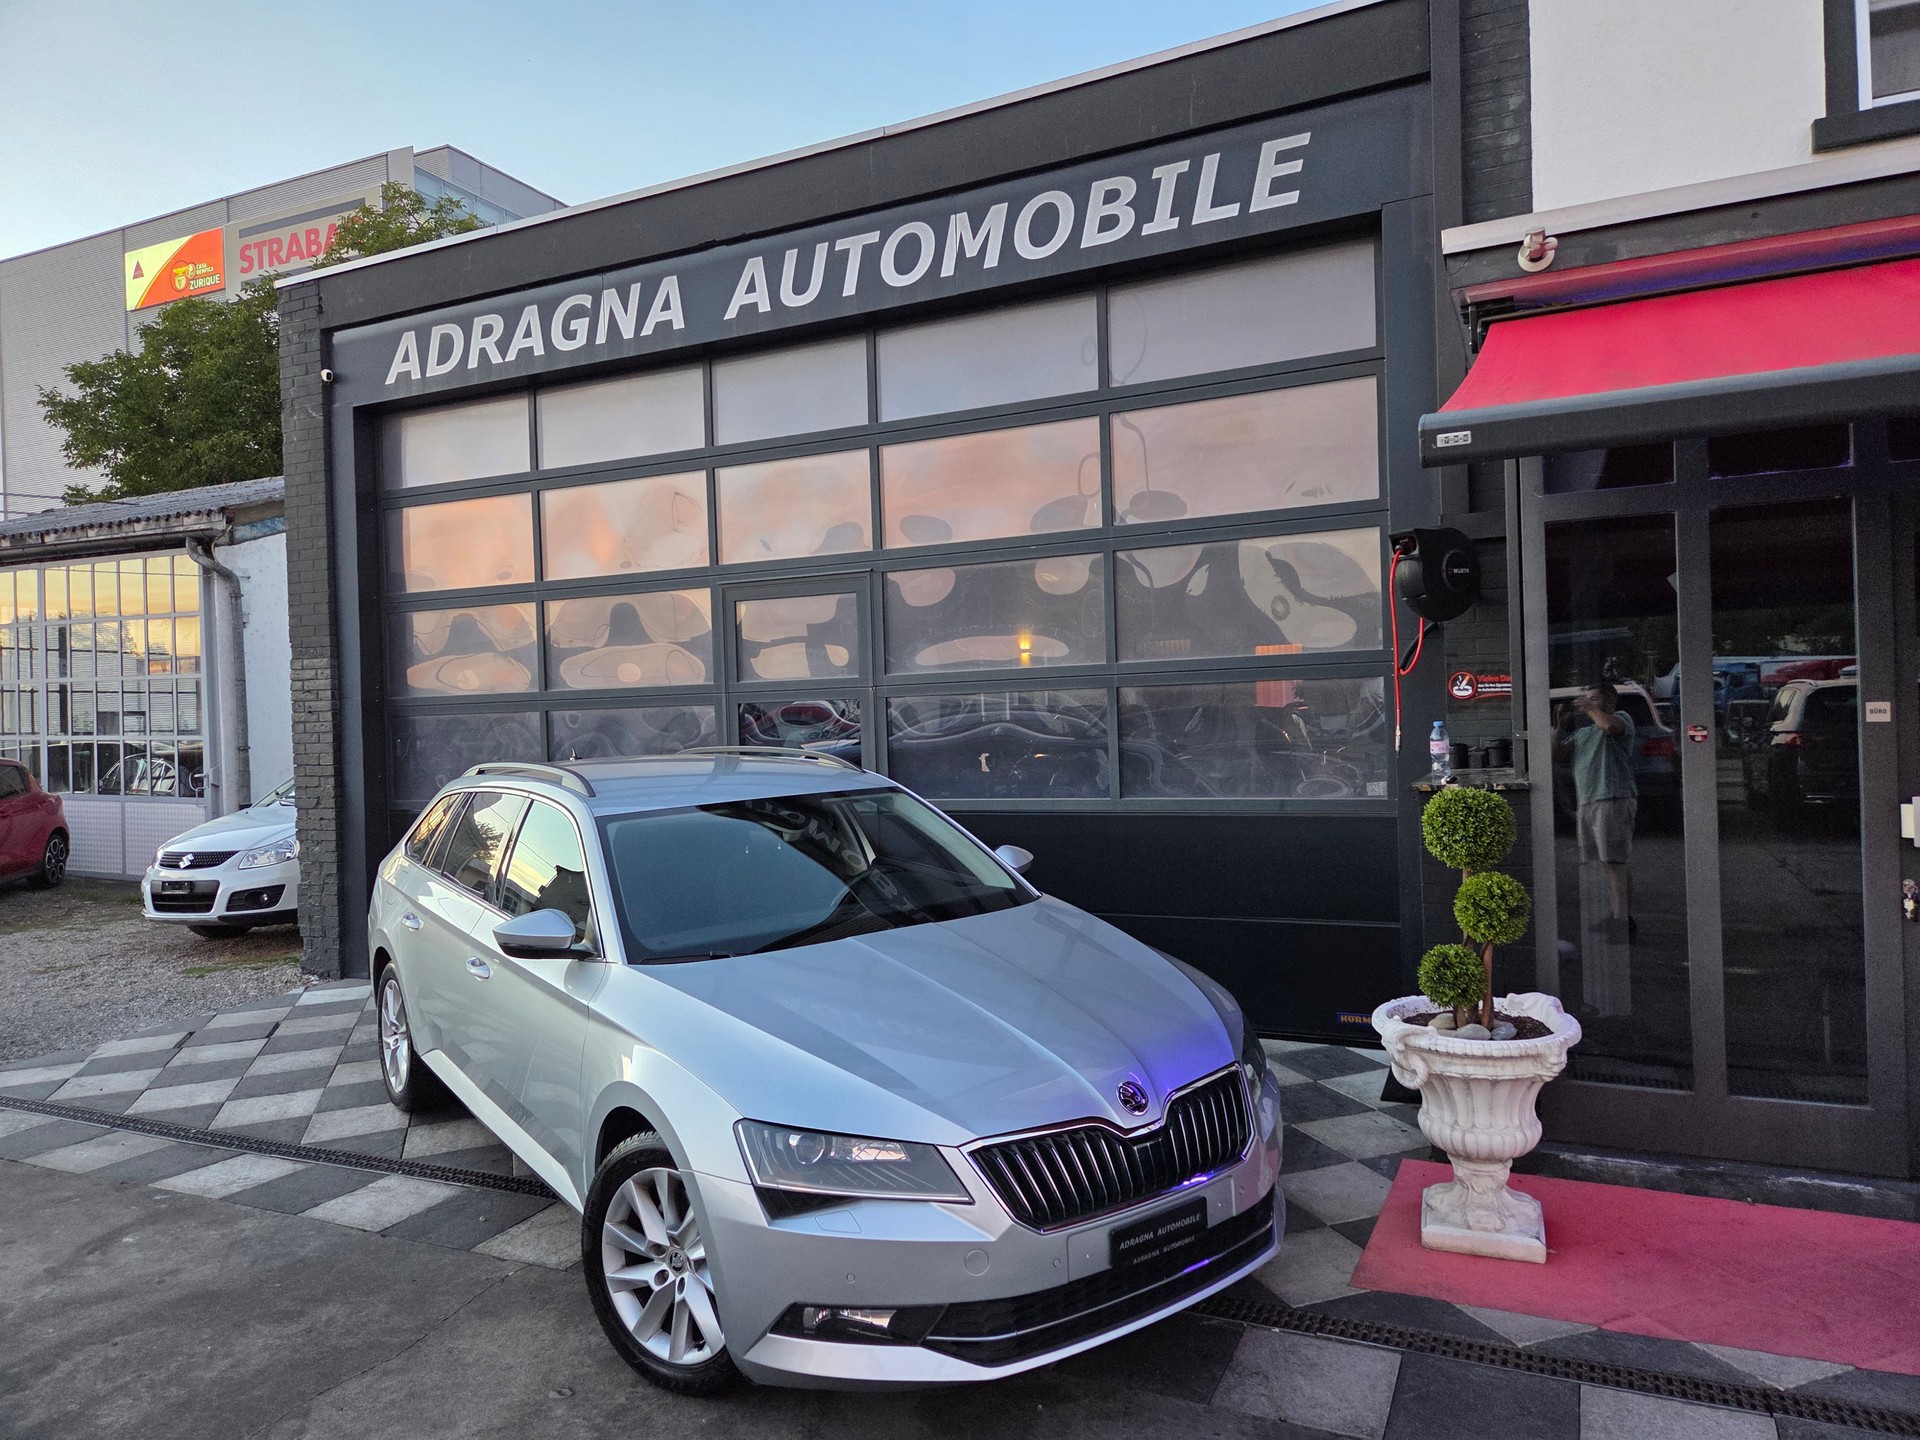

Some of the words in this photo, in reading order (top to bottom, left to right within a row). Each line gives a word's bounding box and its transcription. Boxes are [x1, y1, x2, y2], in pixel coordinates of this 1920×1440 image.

[240, 216, 362, 275] STRABA
[384, 275, 685, 385] ADRAGNA
[723, 132, 1312, 320] AUTOMOBILE
[189, 274, 221, 290] ZURIQUE
[1119, 1232, 1154, 1250] ADRAGNA
[1157, 1212, 1201, 1236] AUTOMOBILE
